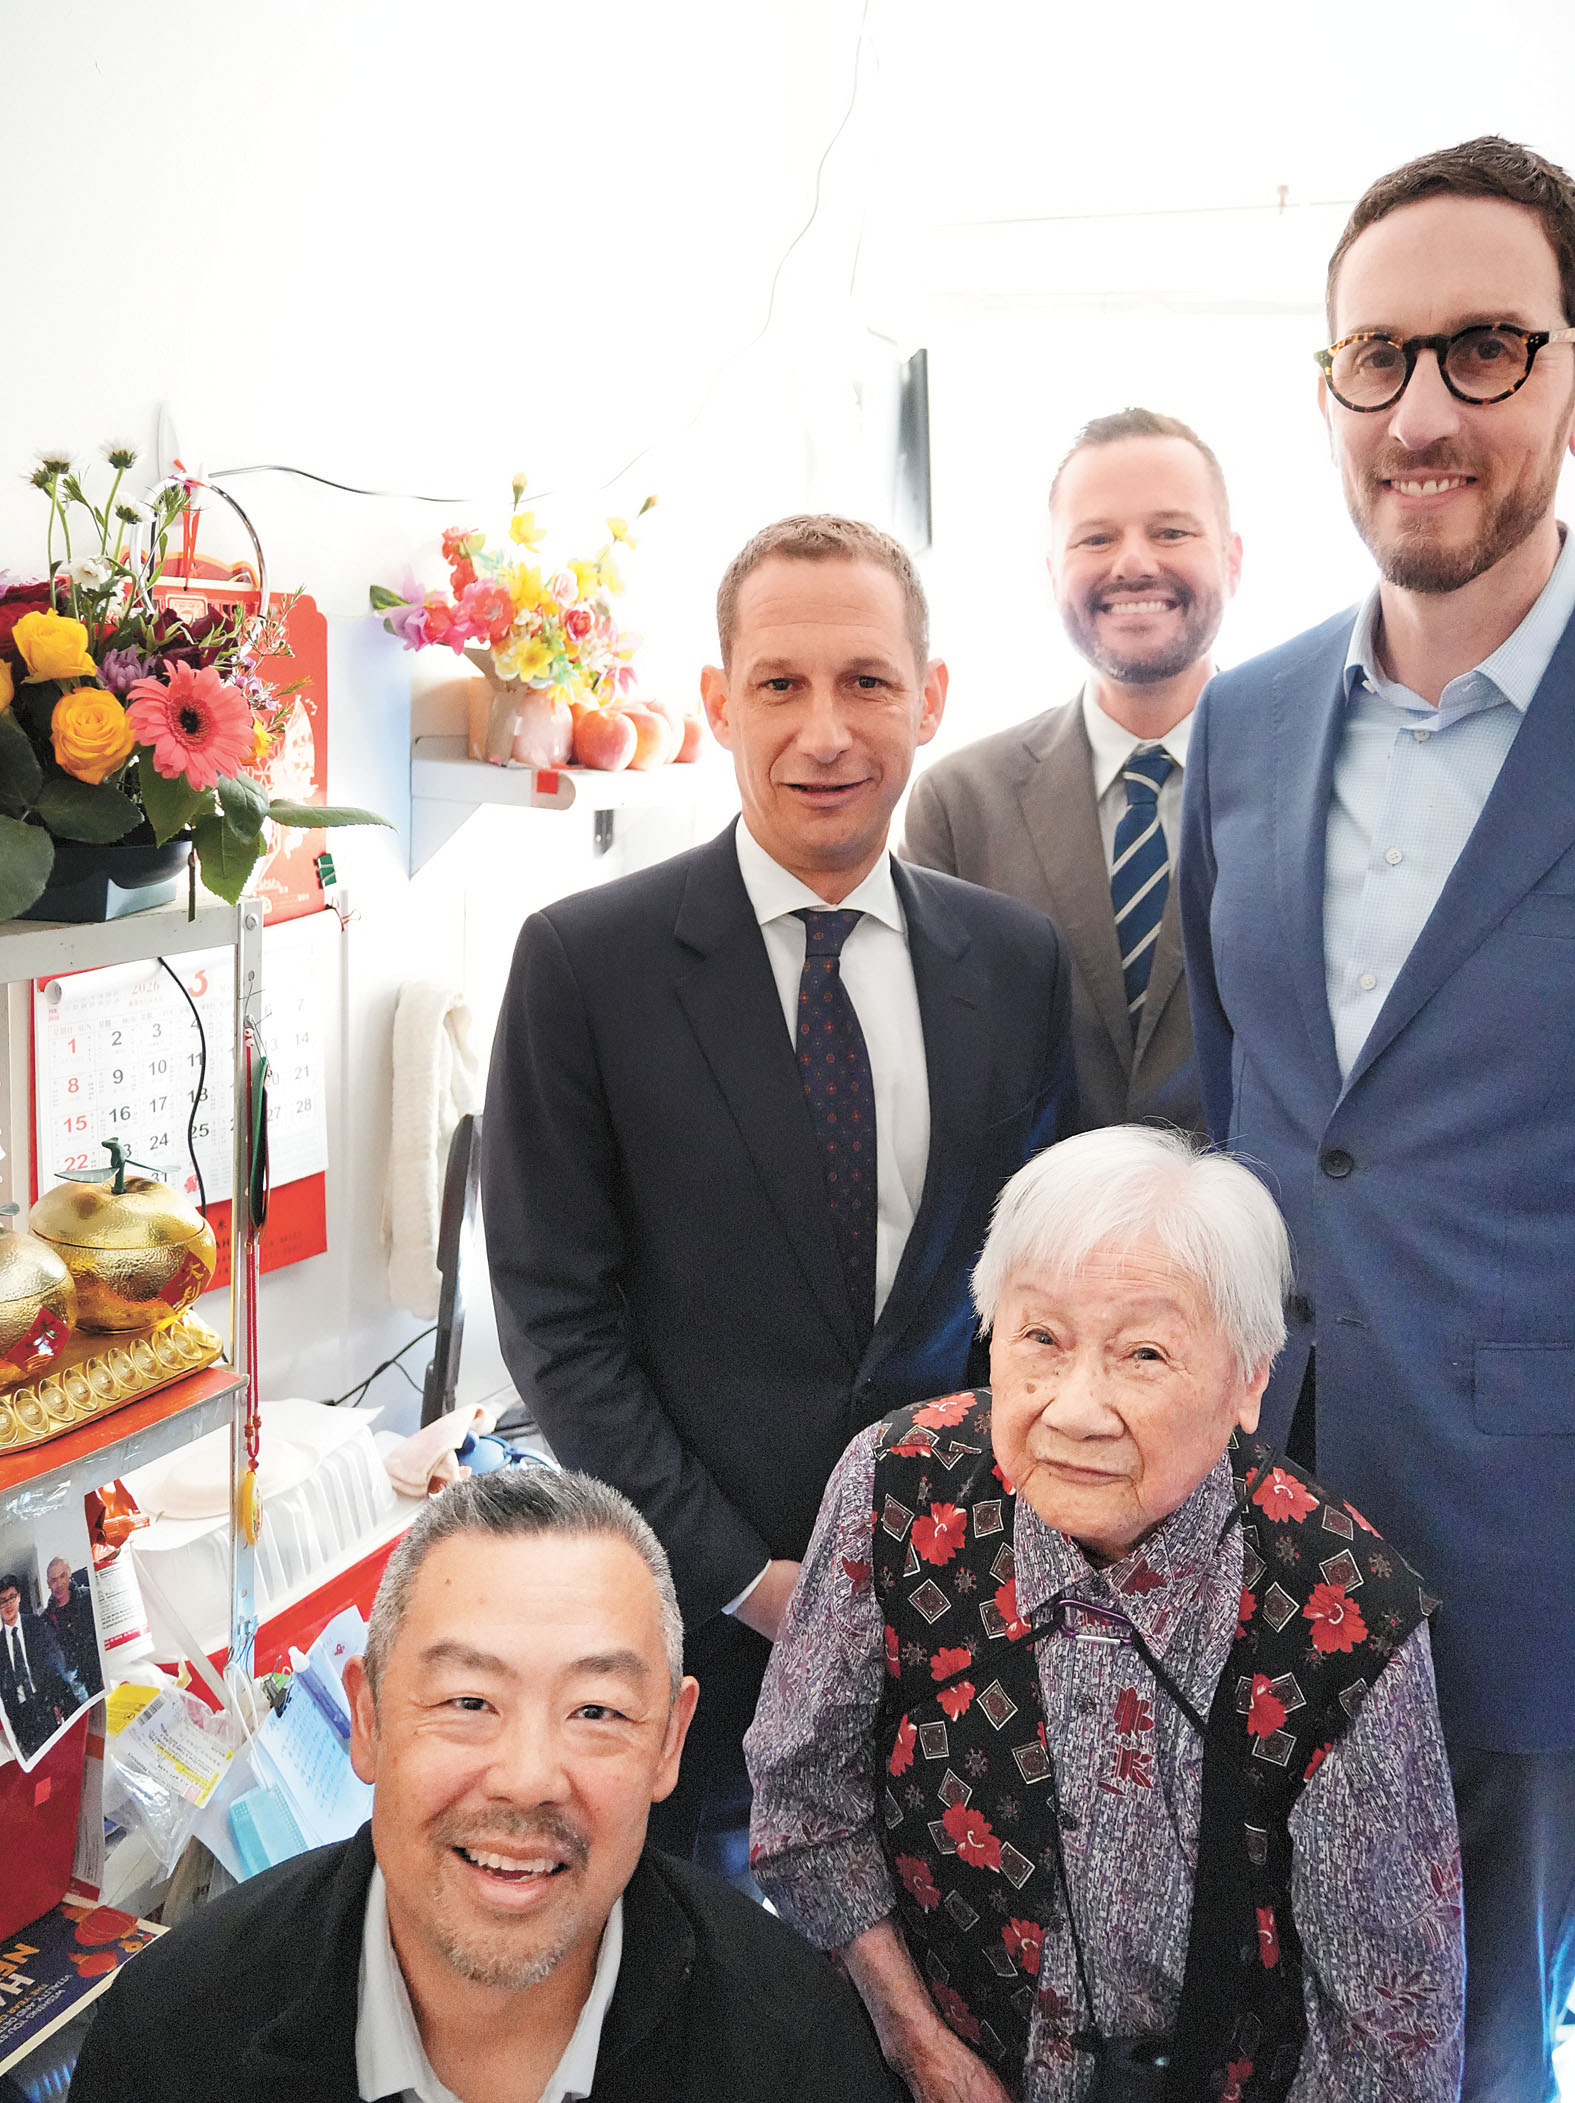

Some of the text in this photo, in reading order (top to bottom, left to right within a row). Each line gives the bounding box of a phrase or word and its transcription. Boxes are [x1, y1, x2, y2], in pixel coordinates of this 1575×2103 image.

[131, 981, 160, 996] 2026
[66, 1037, 77, 1054] 1
[111, 1030, 123, 1047] 2
[152, 1023, 162, 1038] 3
[296, 998, 305, 1013] 7
[67, 1077, 80, 1094] 8
[112, 1069, 124, 1085] 9
[148, 1059, 168, 1076] 10
[295, 1031, 310, 1047] 14
[63, 1114, 88, 1134] 15
[108, 1106, 132, 1124] 16
[149, 1096, 168, 1113] 17
[294, 1064, 311, 1081] 21
[64, 1154, 89, 1172] 22
[149, 1132, 169, 1151] 24
[190, 1123, 210, 1140] 25
[295, 1097, 312, 1115] 28
[15, 2001, 36, 2018] AND
[26, 1988, 66, 2019] WISHING
[7, 2018, 28, 2036] YOU
